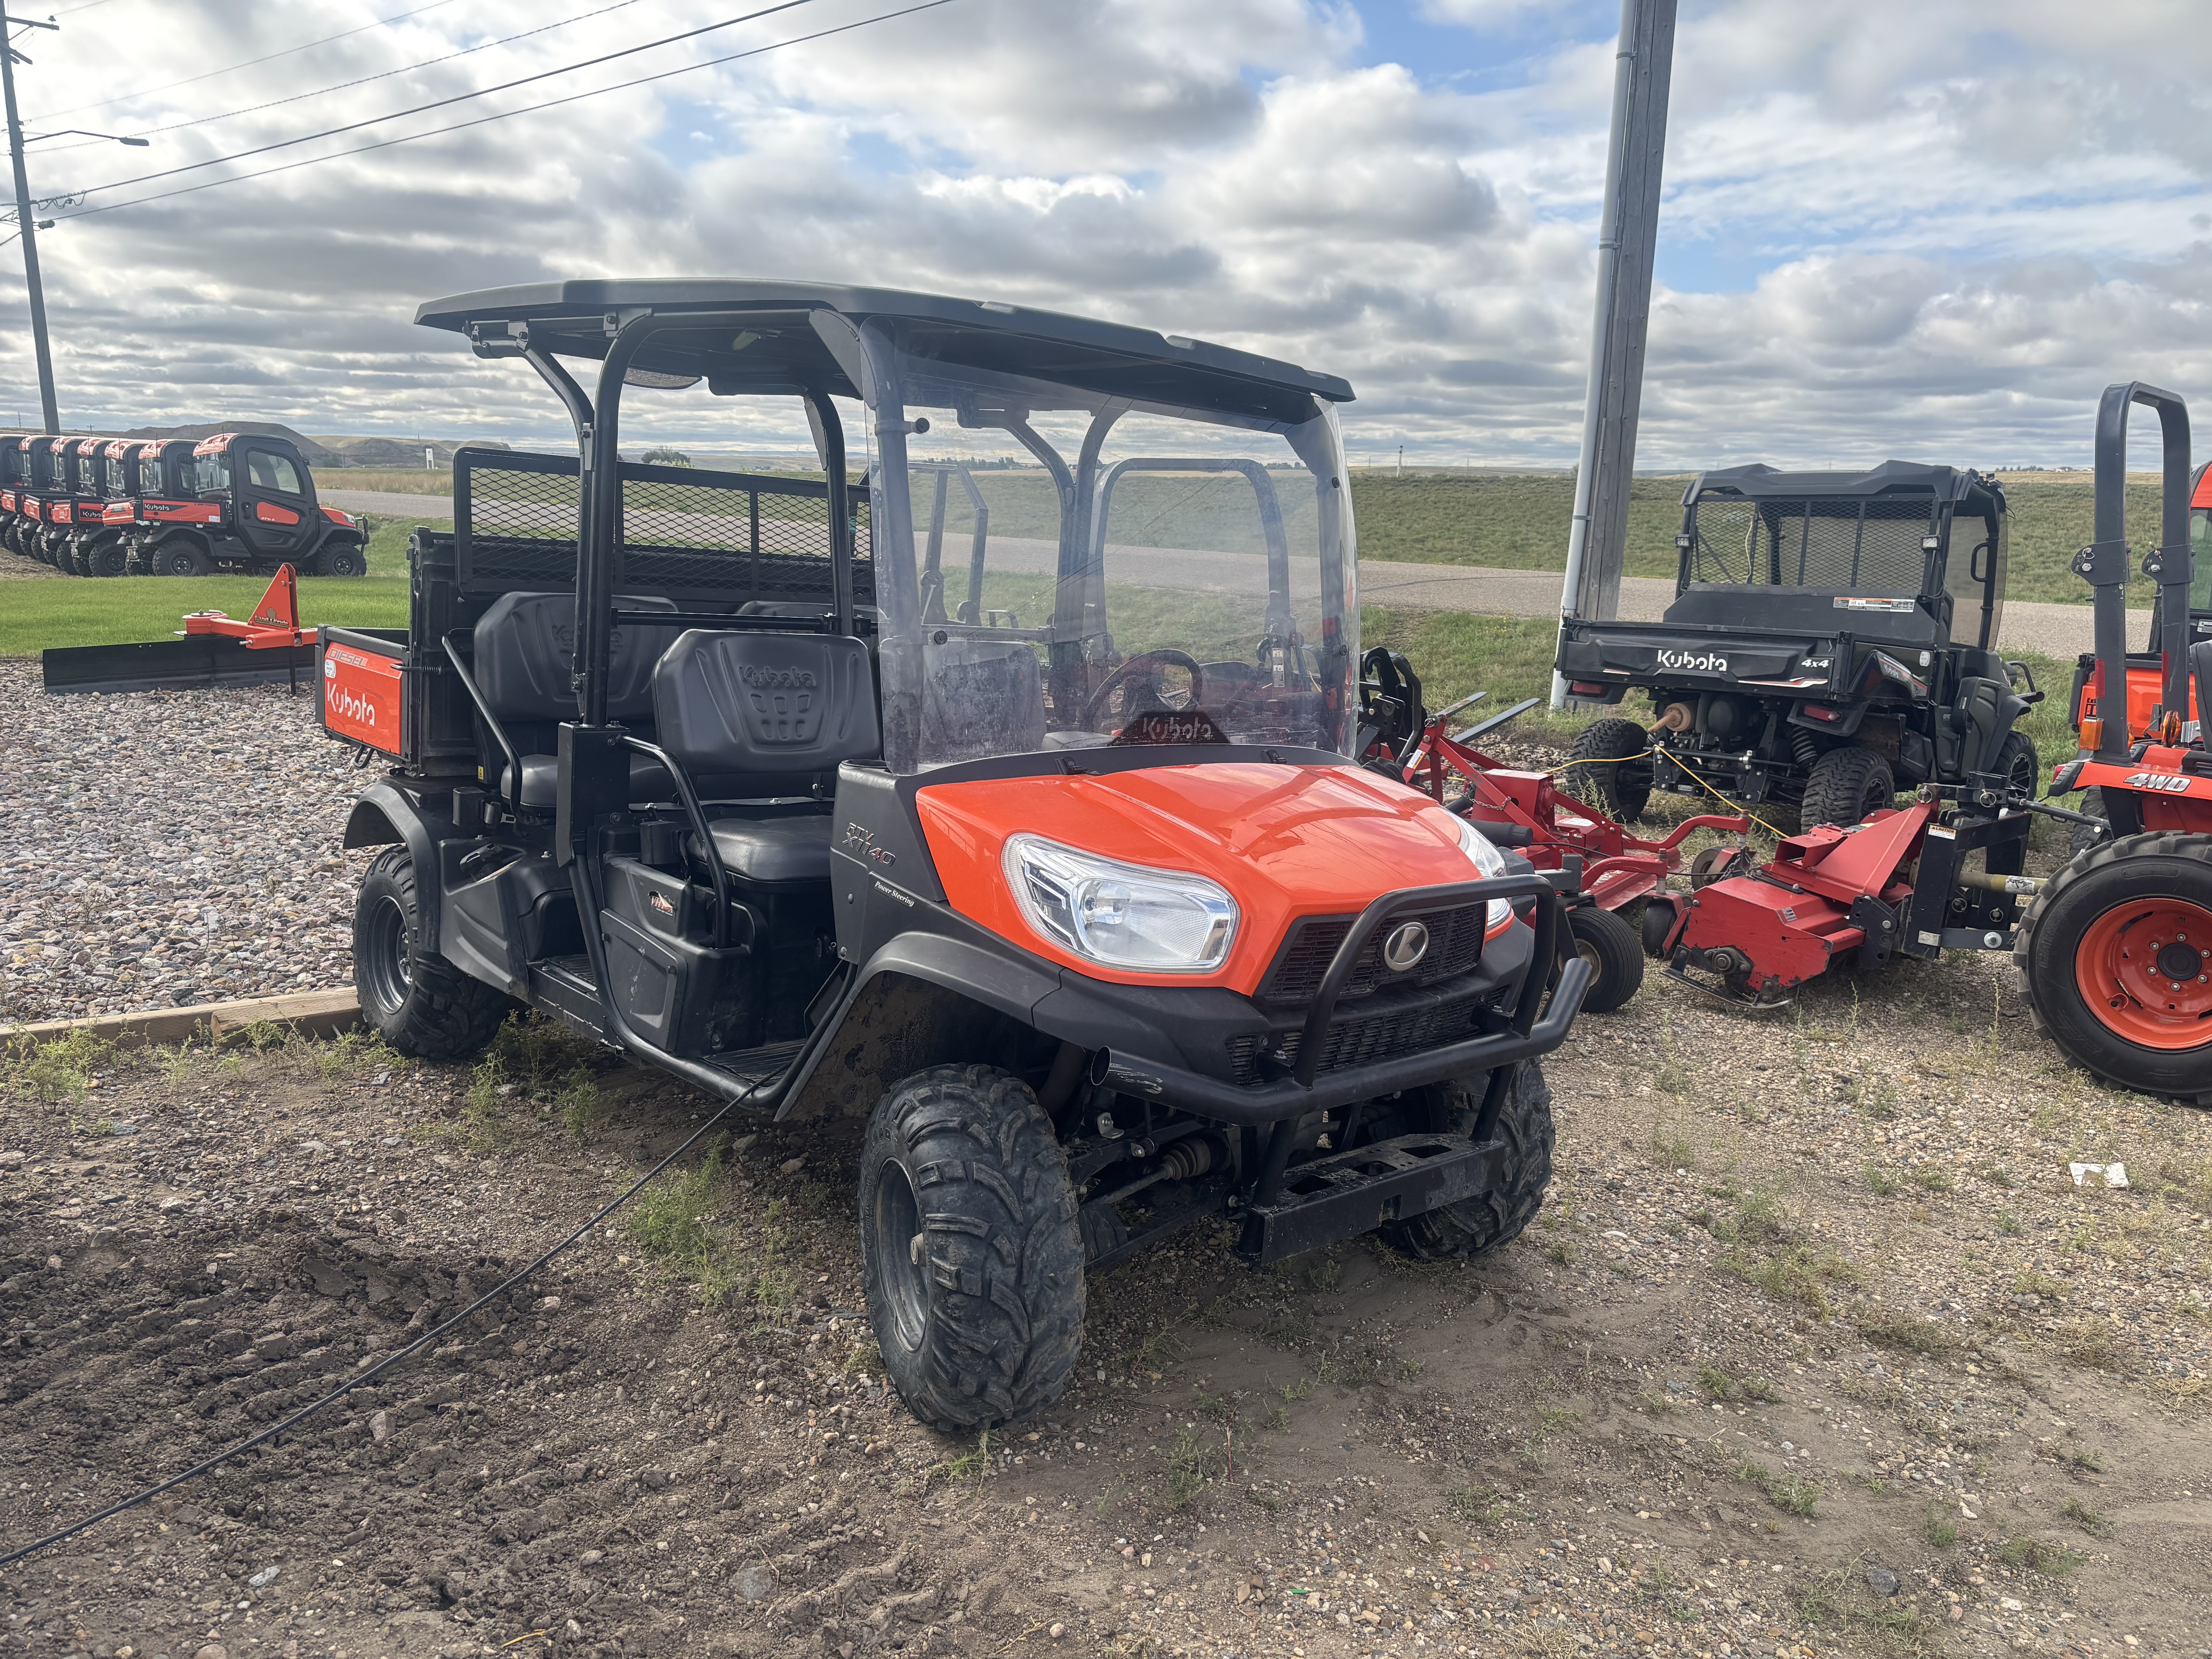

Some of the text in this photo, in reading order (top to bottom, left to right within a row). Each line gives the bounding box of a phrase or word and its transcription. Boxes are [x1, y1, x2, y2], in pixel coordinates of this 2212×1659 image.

[329, 648, 366, 668] DIESEL
[1657, 650, 1727, 671] Kubota
[1801, 659, 1829, 668] 4x4
[738, 666, 816, 687] Kubota
[327, 681, 375, 726] Kubota
[1143, 717, 1211, 740] Kubota
[2124, 773, 2191, 793] 4WD
[847, 823, 874, 840] RTV
[842, 832, 896, 866] X1140
[875, 881, 915, 907] Power Steering
